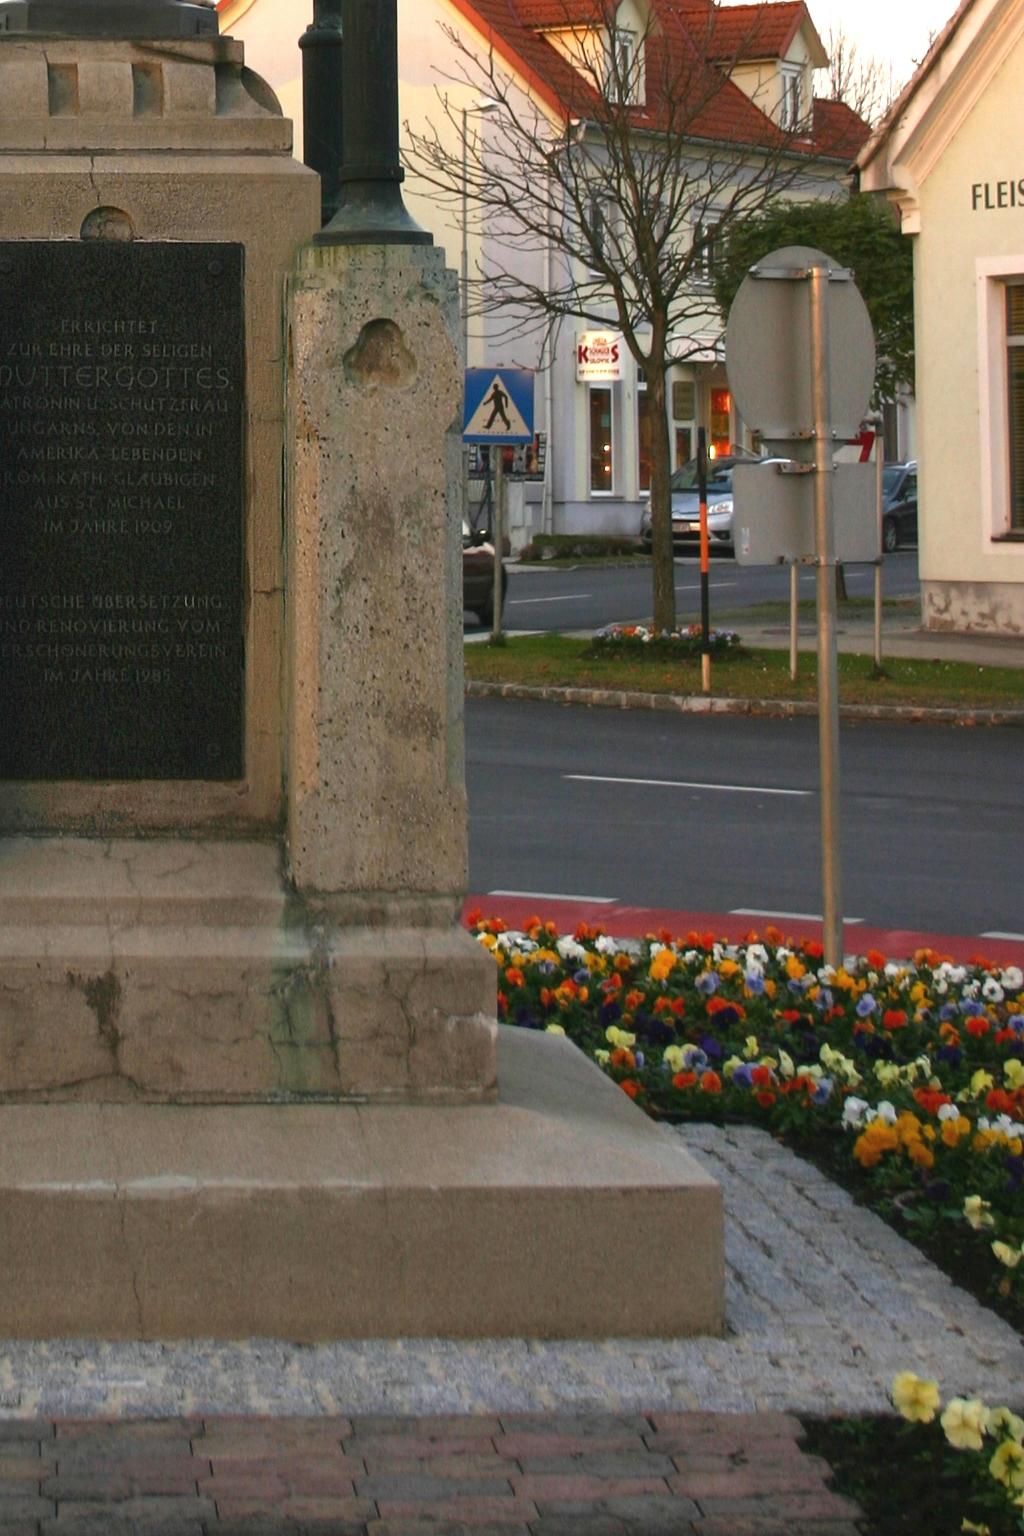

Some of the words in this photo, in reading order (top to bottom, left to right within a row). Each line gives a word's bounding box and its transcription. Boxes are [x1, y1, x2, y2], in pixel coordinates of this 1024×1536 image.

[61, 320, 157, 333] ERRICHTET
[7, 343, 42, 356] ZUR
[49, 343, 92, 357] EHRE
[101, 343, 135, 358] DER
[142, 344, 212, 358] SELIGEN
[109, 397, 228, 412] SCHUTZFRAU
[107, 422, 148, 435] VON
[154, 422, 189, 436] DEN
[196, 422, 212, 436] IN
[17, 446, 99, 460] AMERIKA
[111, 447, 202, 462] LEBENDEN
[34, 495, 69, 509] AUS
[107, 496, 186, 510] MICHAEL
[43, 520, 63, 534] IM
[71, 519, 129, 534] JAHRE
[135, 520, 173, 534] 1909
[37, 619, 169, 634] RENOVIERUNG
[176, 619, 221, 633] VOM
[43, 668, 63, 683] IM
[70, 668, 129, 683] JAHRE
